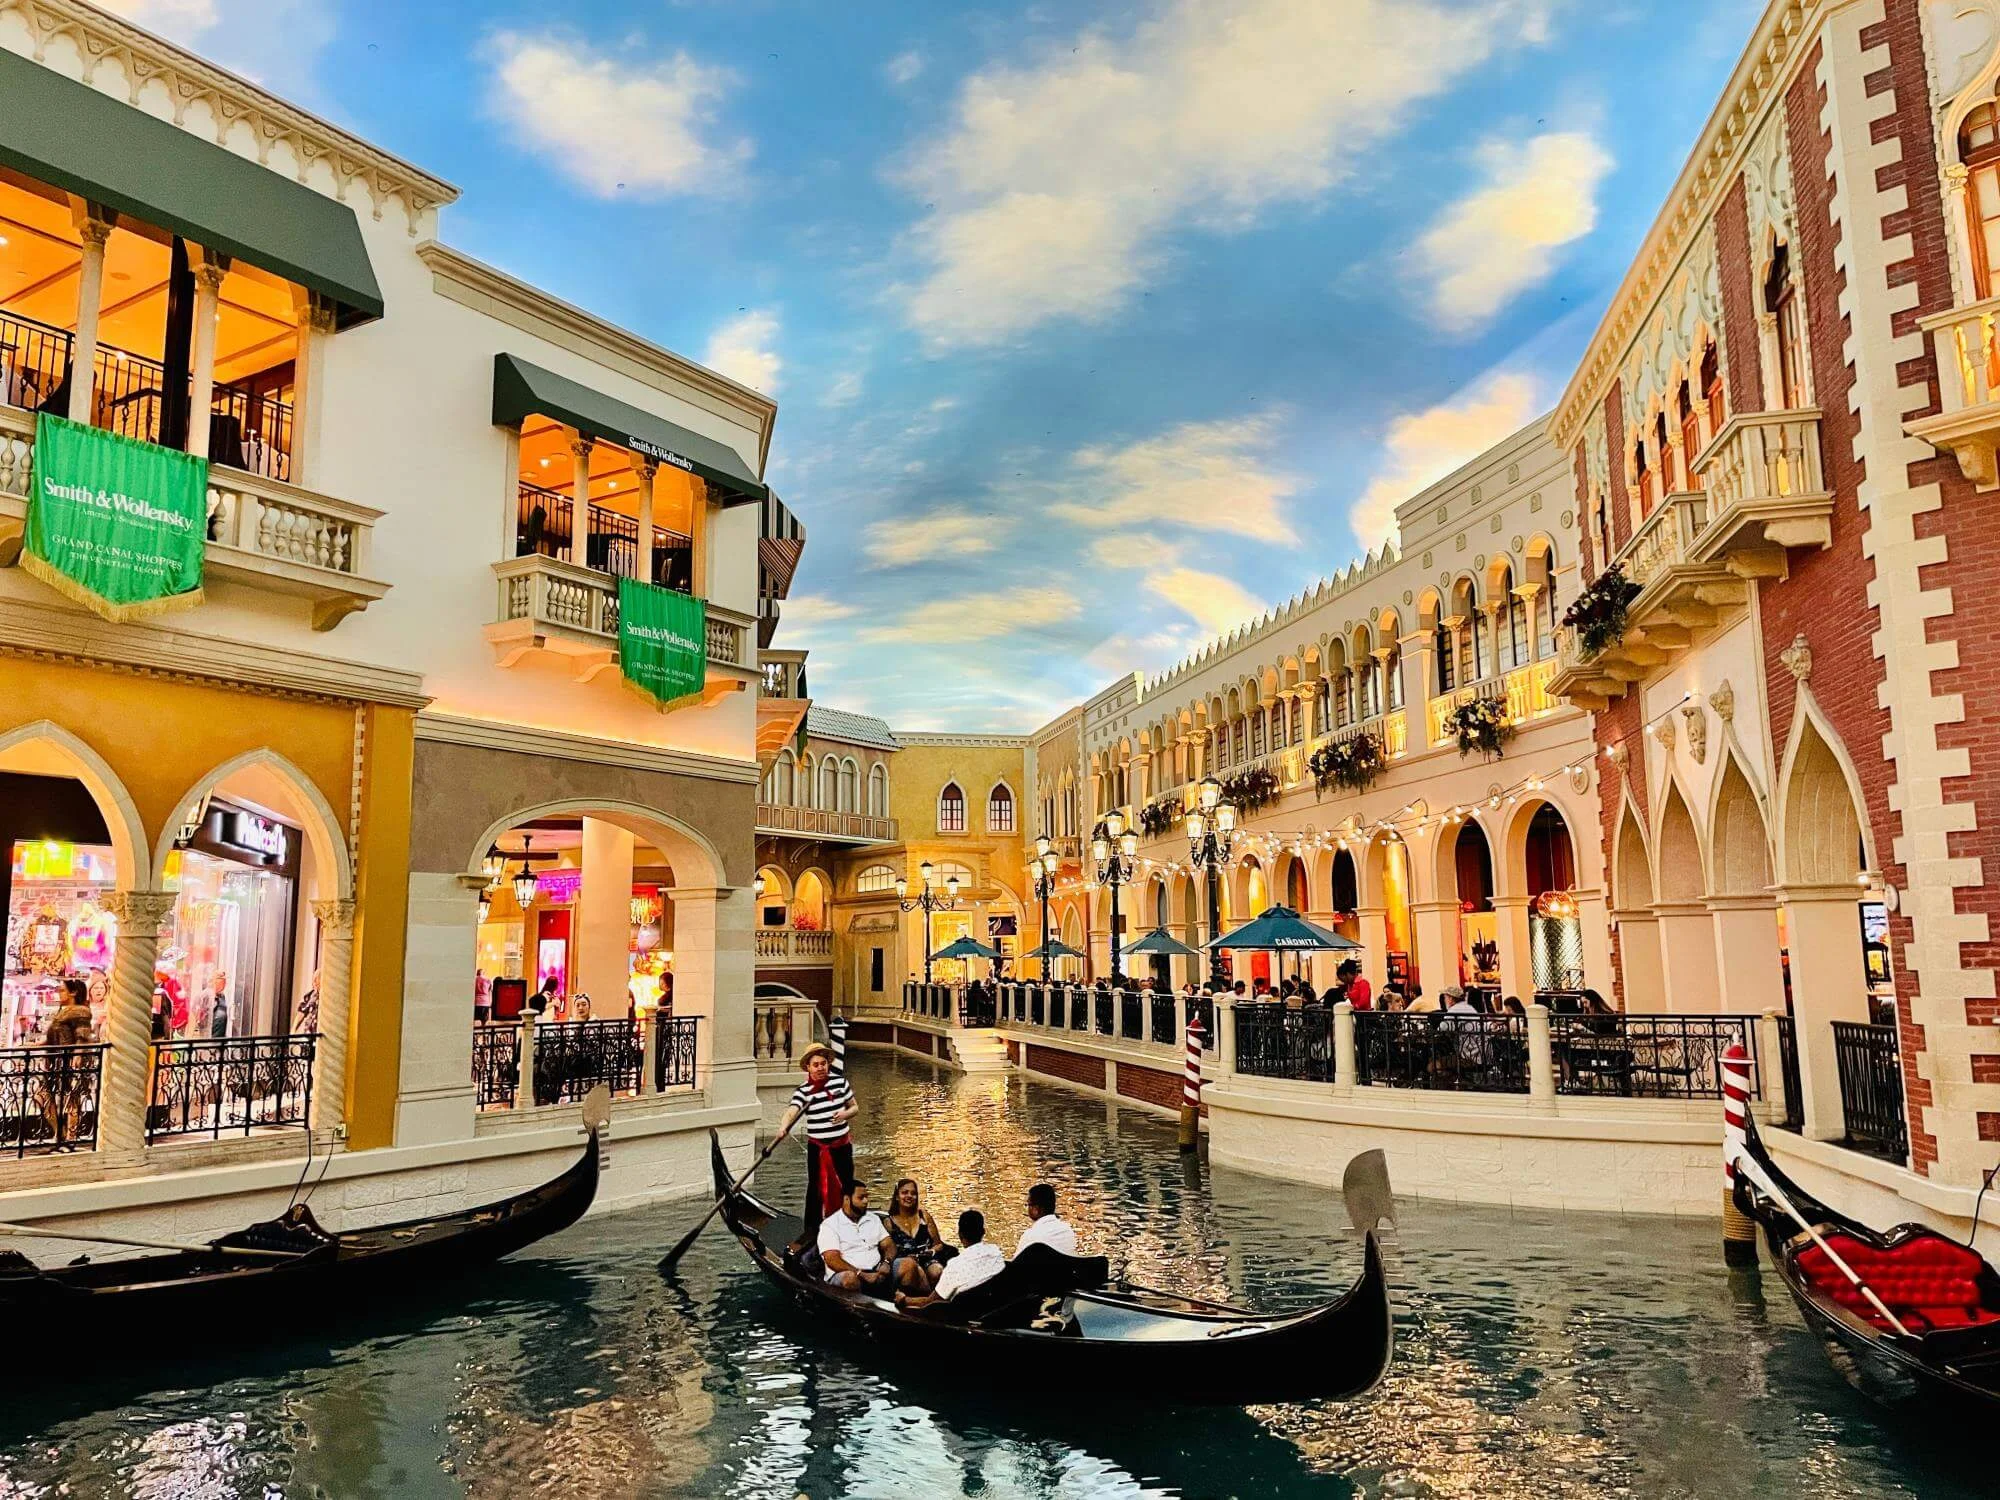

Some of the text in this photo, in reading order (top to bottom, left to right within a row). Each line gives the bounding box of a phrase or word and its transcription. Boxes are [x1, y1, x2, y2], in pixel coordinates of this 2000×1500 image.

[628, 436, 694, 471] Smith & Wollensky
[44, 476, 93, 504] Smith
[95, 489, 112, 509] &
[112, 491, 194, 531] Wollensky
[52, 534, 183, 571] GRAND CANAL SHOPPES
[626, 621, 652, 638] Smith
[652, 626, 661, 640] &
[660, 628, 701, 653] Wollensky
